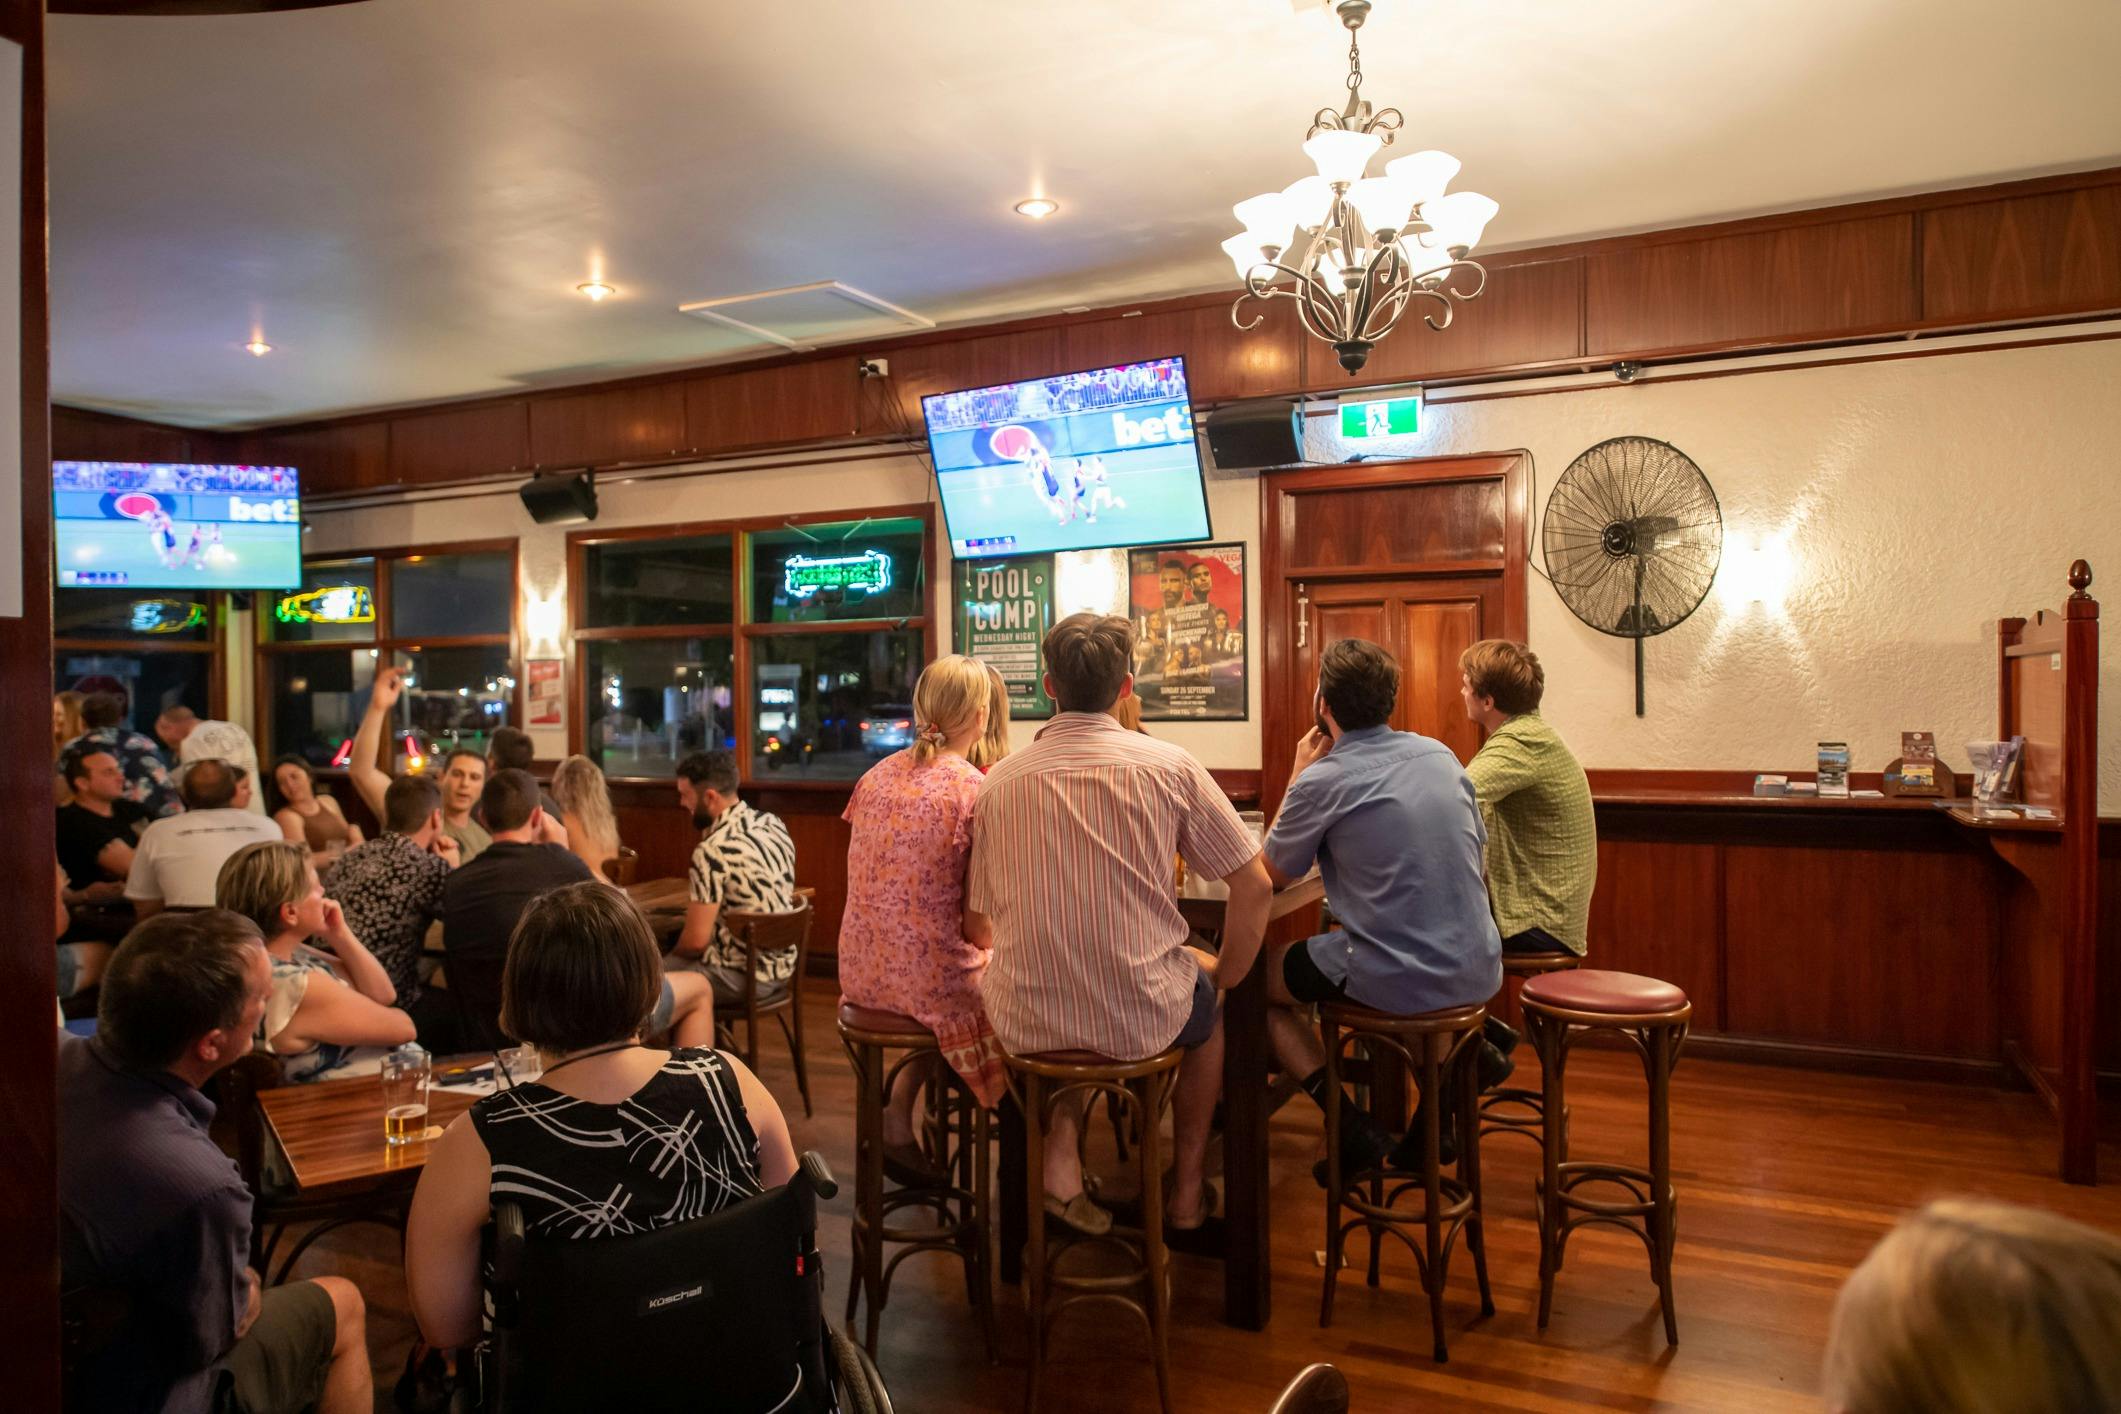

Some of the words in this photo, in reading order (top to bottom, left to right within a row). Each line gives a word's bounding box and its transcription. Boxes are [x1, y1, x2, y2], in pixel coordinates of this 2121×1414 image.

[977, 568, 1034, 600] POOL
[975, 600, 1036, 631] COMP
[974, 633, 1013, 643] WEDNESDAY
[1015, 631, 1037, 641] NIGHT
